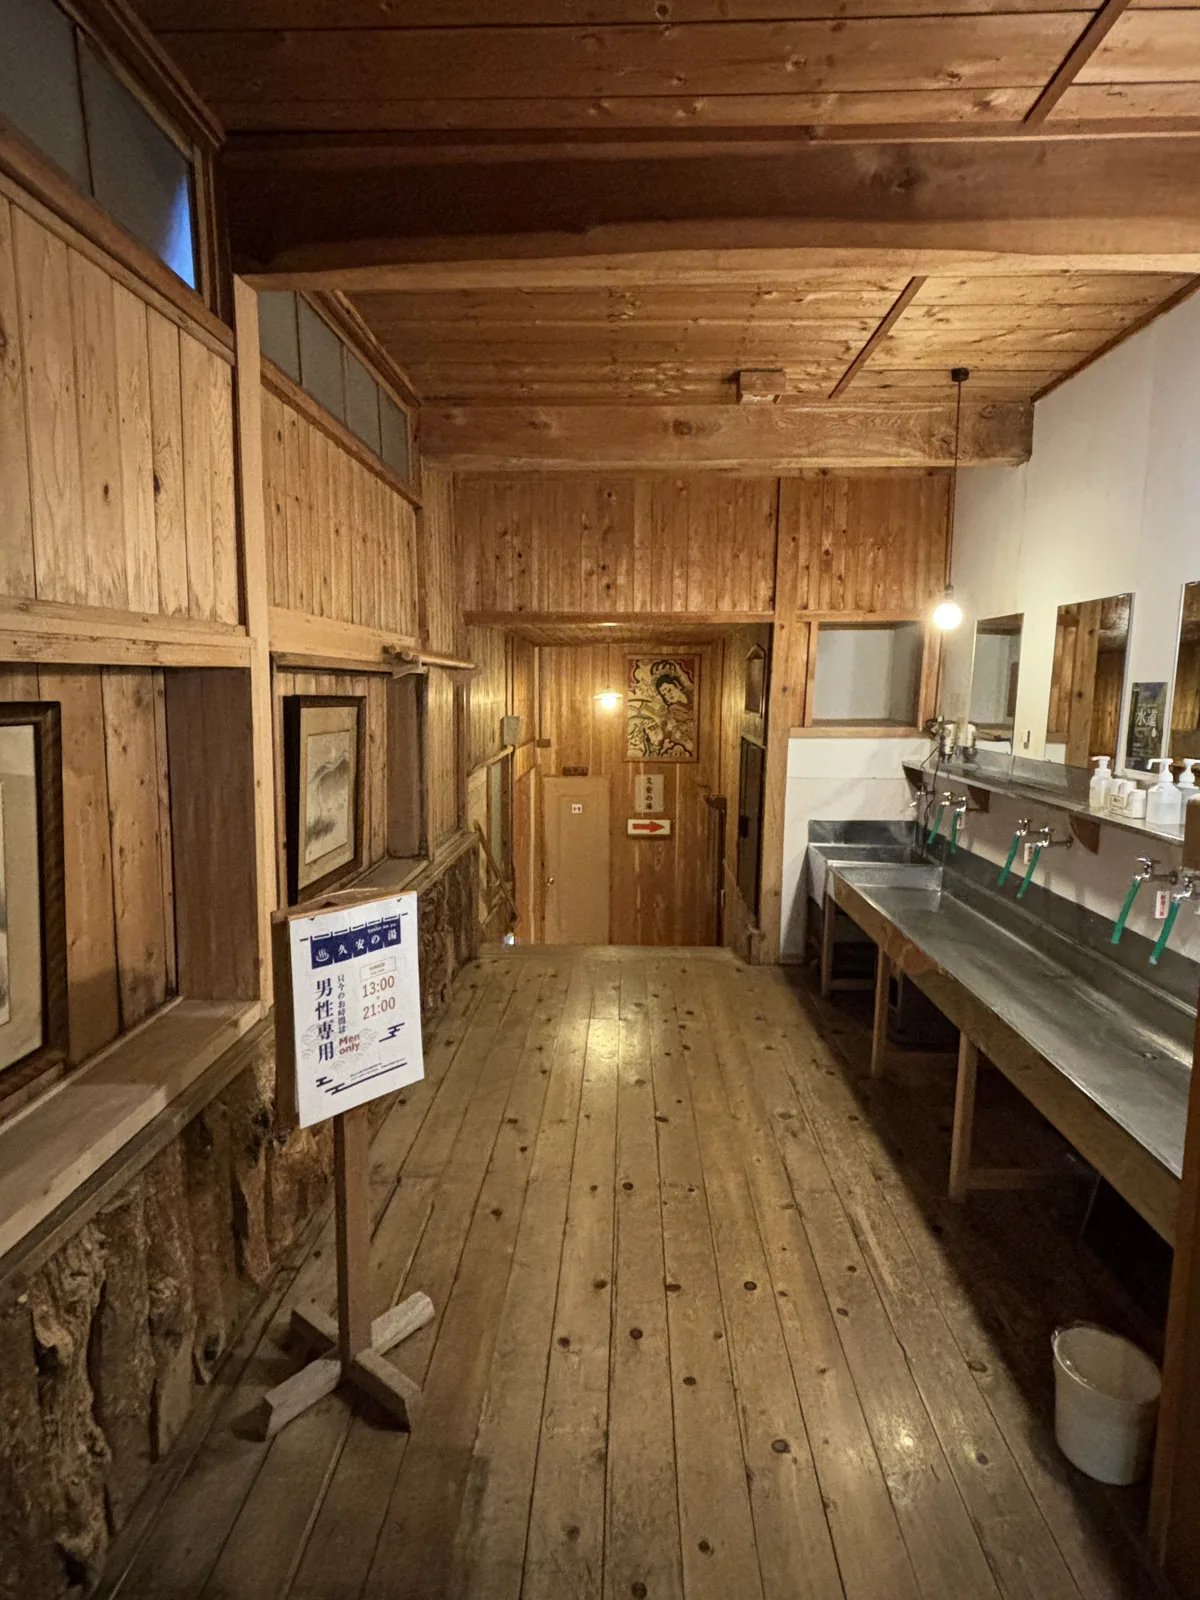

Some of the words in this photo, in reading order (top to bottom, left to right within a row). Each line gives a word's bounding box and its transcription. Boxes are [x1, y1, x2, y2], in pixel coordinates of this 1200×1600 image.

[338, 929, 397, 955] 久安の湯
[362, 975, 395, 999] 13:00
[337, 974, 346, 1034] 只今のお時間は
[362, 996, 396, 1020] 21:00
[315, 978, 334, 1064] 男性専用
[338, 1033, 360, 1046] Men
[338, 1042, 360, 1055] only
